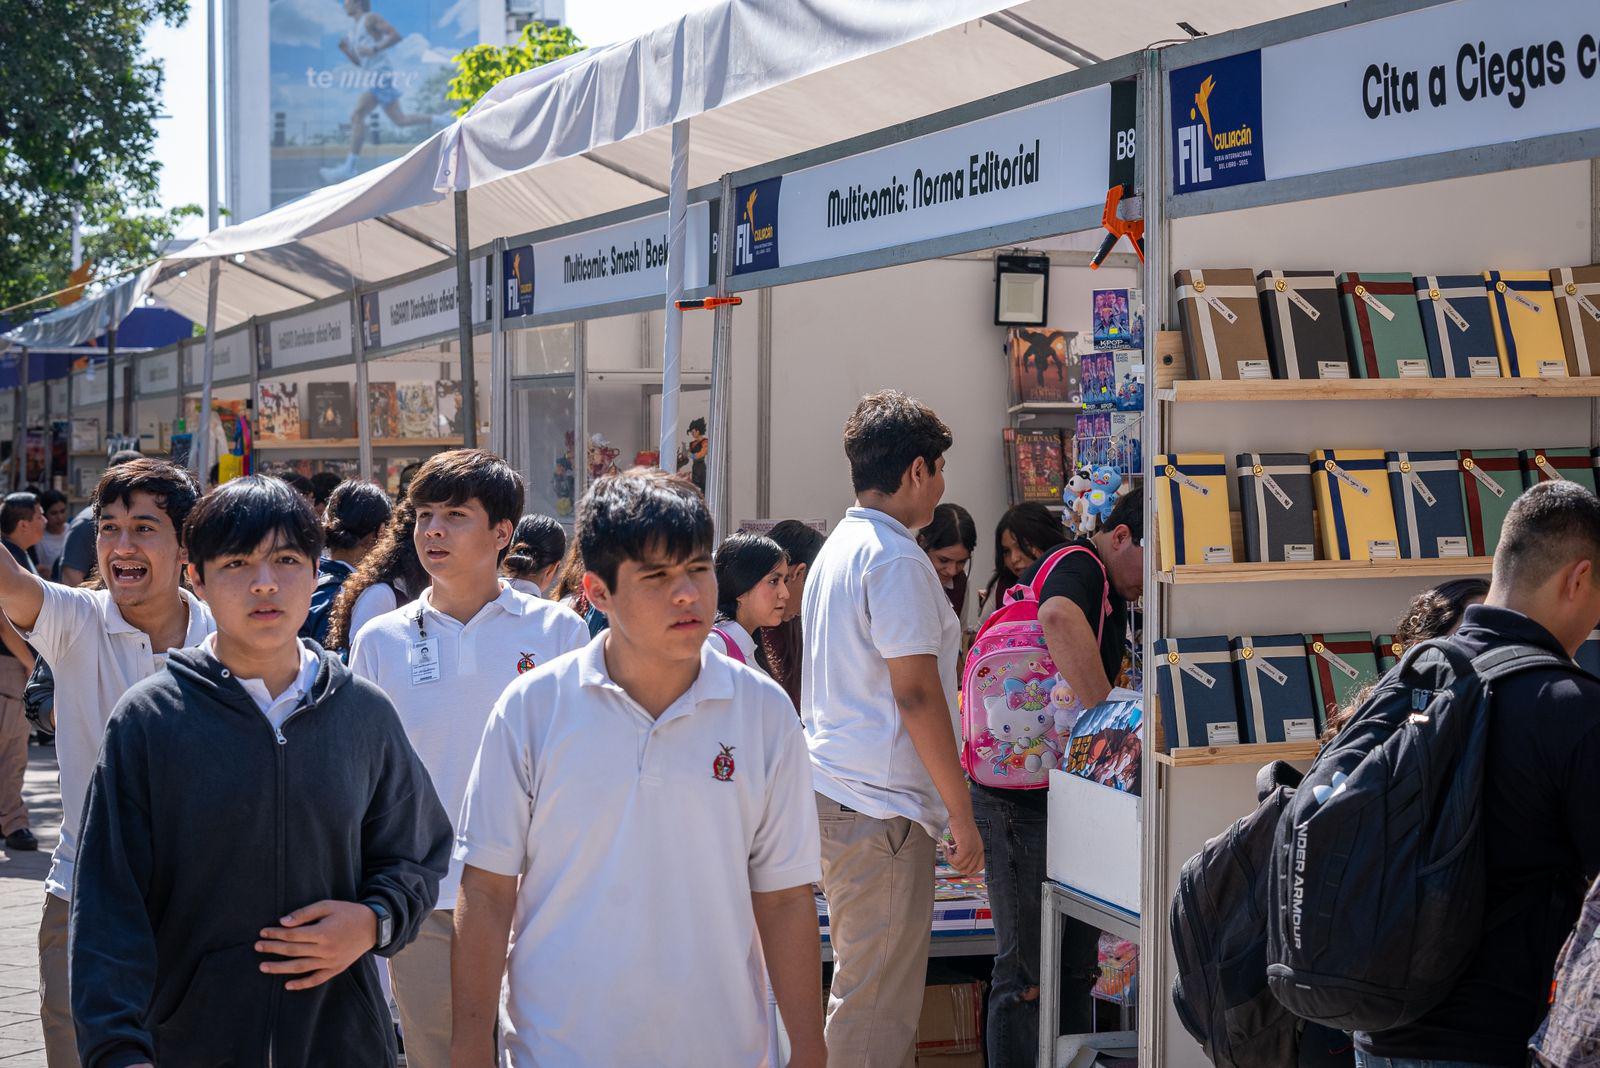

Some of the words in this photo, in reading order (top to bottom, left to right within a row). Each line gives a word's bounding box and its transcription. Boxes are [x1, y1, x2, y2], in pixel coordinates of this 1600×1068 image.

[306, 66, 333, 89] te
[1362, 62, 1419, 119] Cita
[1428, 65, 1446, 107] a
[1456, 41, 1566, 109] Ciegas
[1577, 34, 1600, 79] c
[1117, 128, 1135, 160] B8
[1178, 123, 1212, 185] FIL
[1214, 124, 1252, 151] CULIACÁN
[827, 176, 908, 228] Multicomic:
[913, 169, 964, 209] Norma
[969, 139, 1040, 196] Editorial
[564, 249, 608, 284] Multicomic:
[736, 222, 753, 266] FIL
[1295, 824, 1309, 875] NDER
[1292, 876, 1305, 949] ARMOUR
